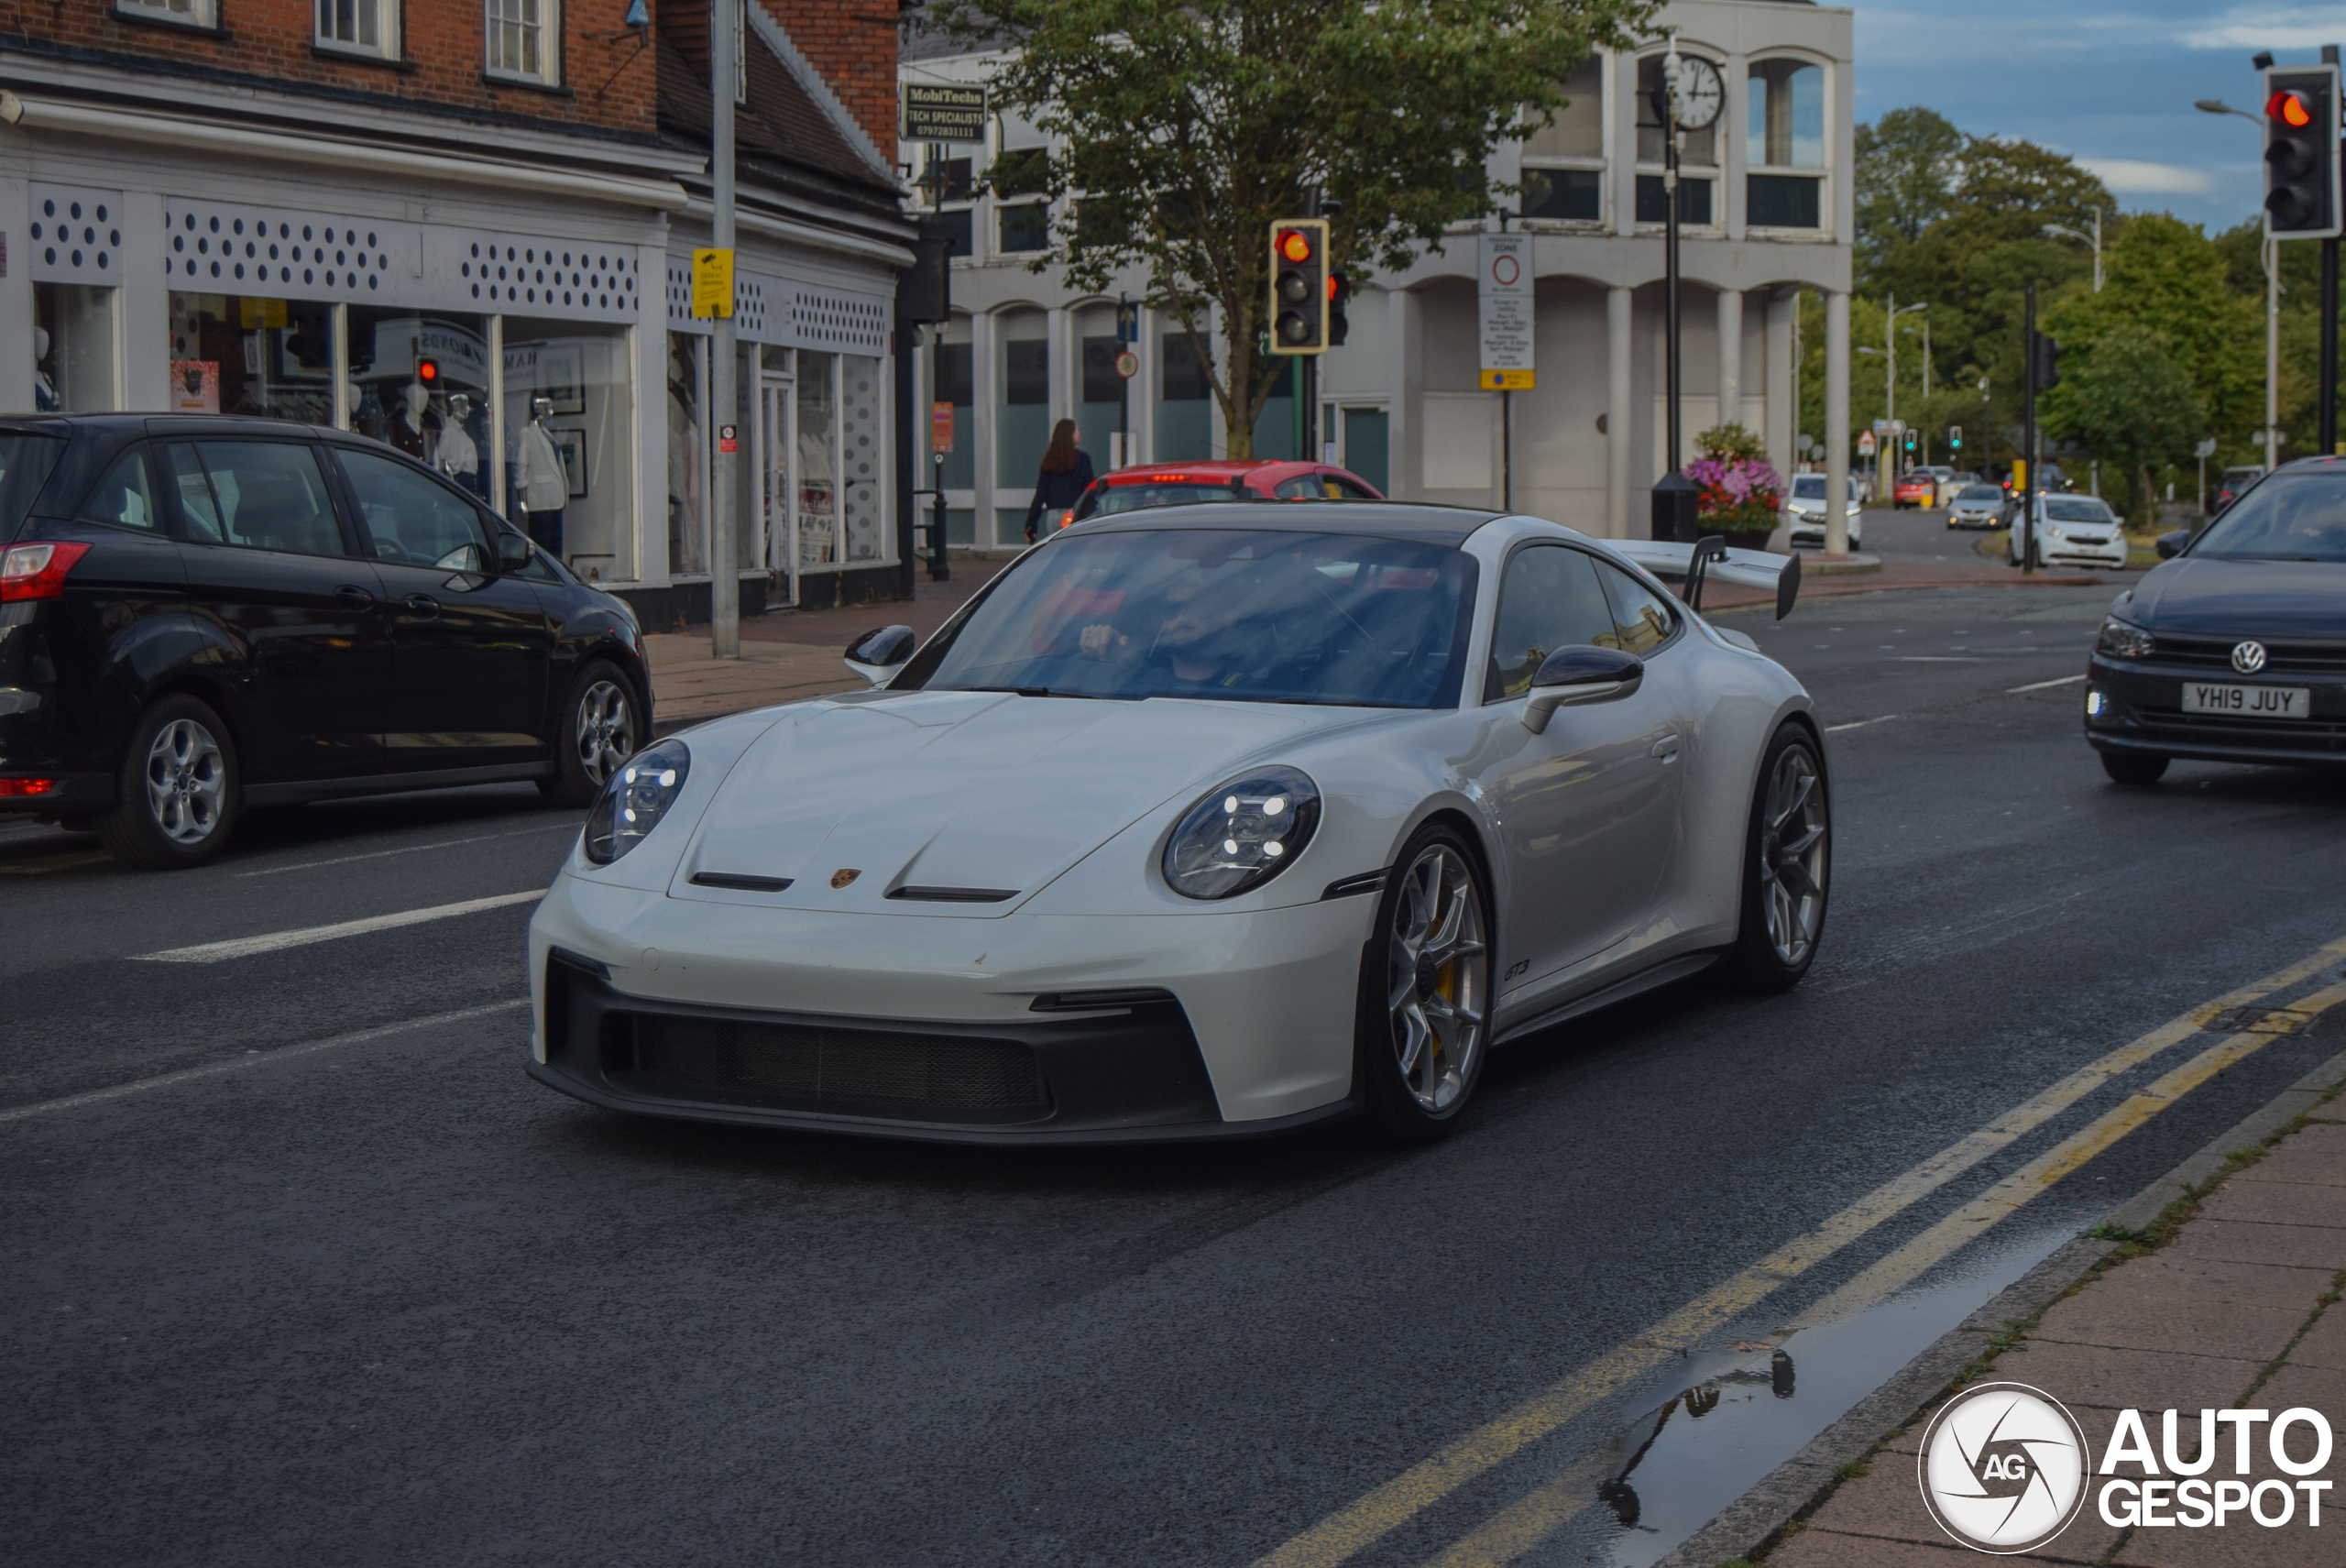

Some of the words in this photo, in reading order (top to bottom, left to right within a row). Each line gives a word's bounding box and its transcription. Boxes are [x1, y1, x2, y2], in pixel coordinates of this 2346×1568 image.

[910, 88, 982, 104] MobiTechs
[908, 110, 930, 122] TECH
[932, 111, 984, 125] SPECIALISTS
[1494, 244, 1518, 252] ZONE
[2197, 687, 2243, 709] YH19
[2251, 691, 2294, 711] JUY
[1504, 959, 1530, 981] GT3
